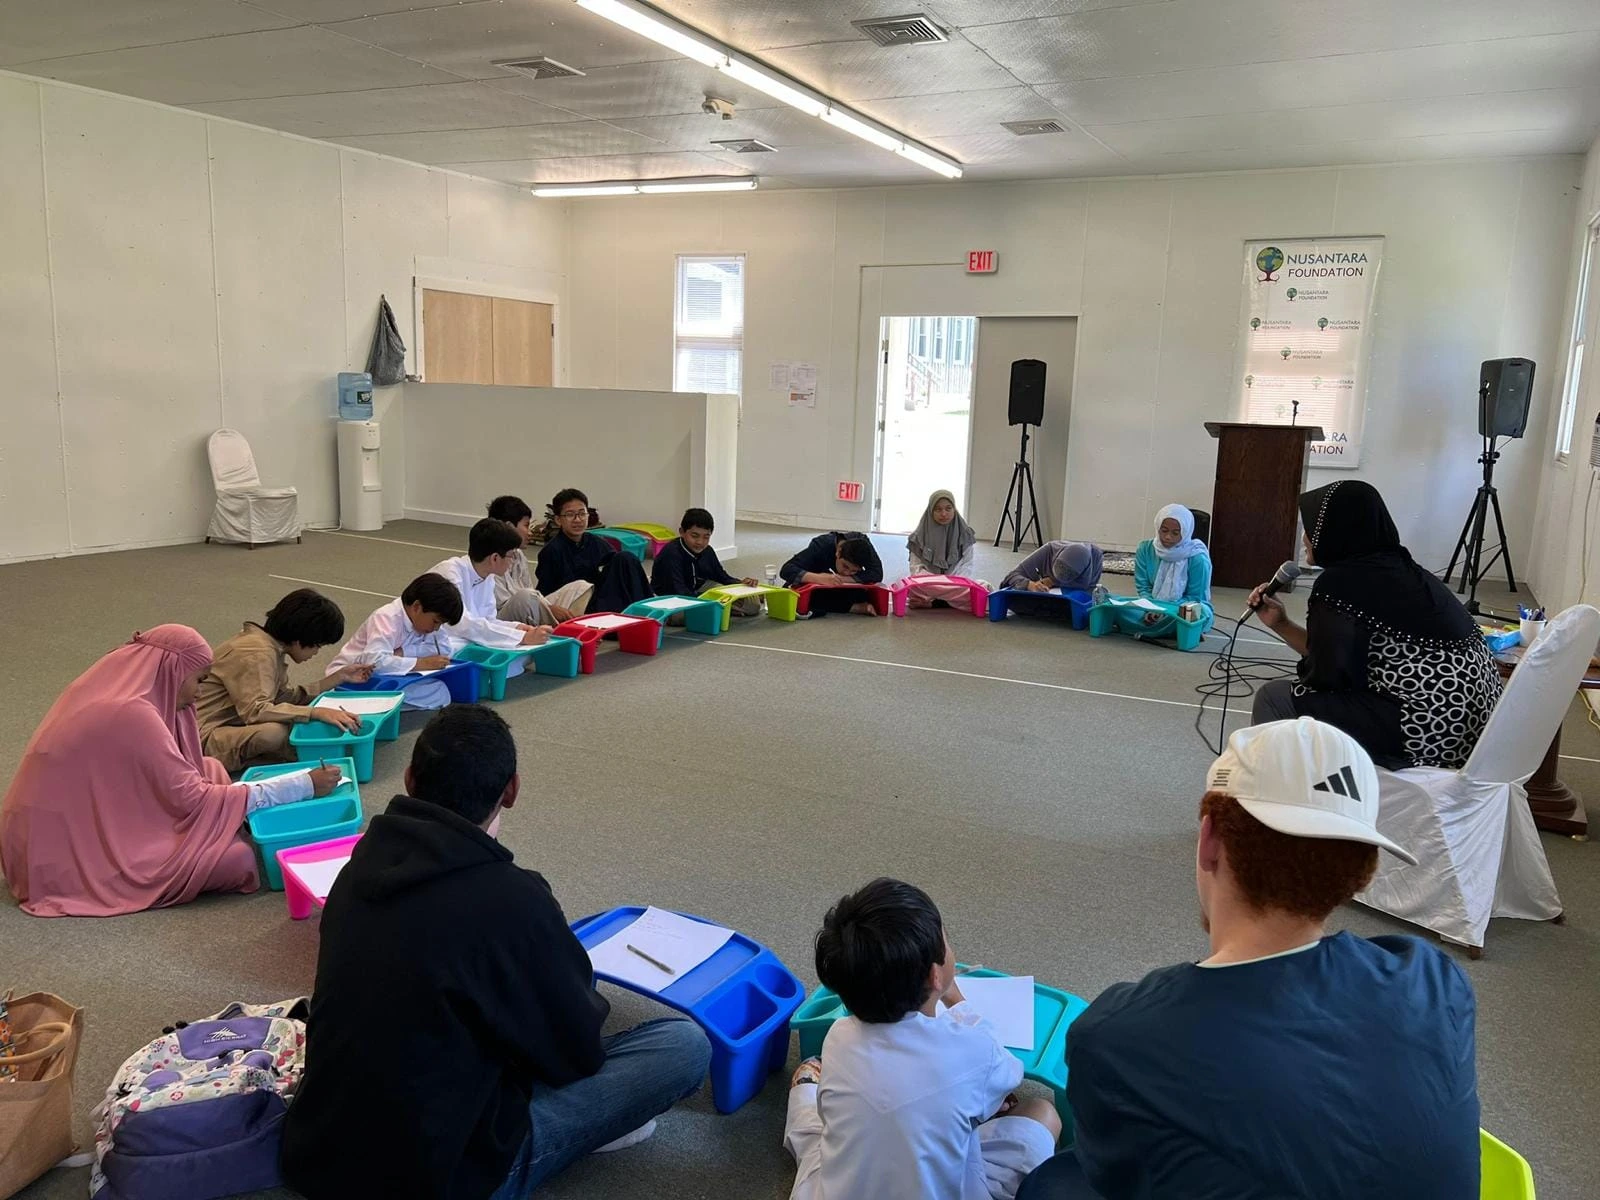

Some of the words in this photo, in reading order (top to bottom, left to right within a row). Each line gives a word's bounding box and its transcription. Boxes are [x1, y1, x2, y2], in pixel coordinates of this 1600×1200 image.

[969, 251, 993, 271] EXIT
[1286, 252, 1368, 265] NUSANTARA
[1288, 267, 1364, 278] FOUNDATION
[1310, 445, 1344, 455] ATION
[839, 482, 860, 500] EXIT
